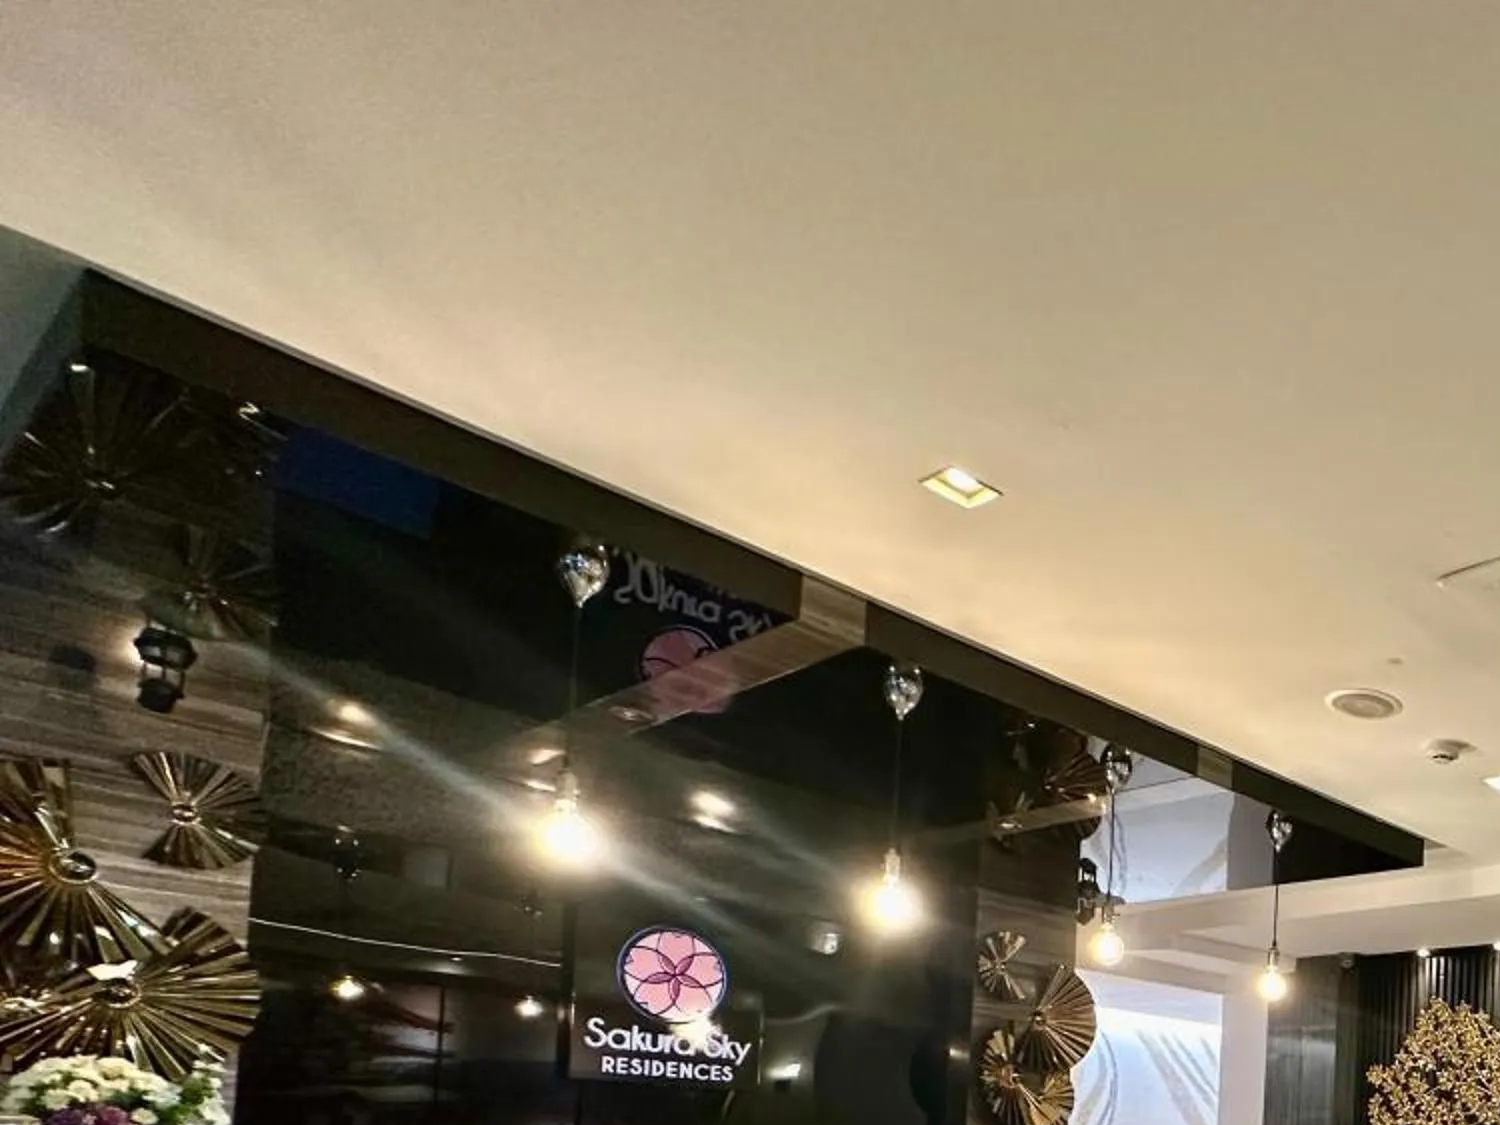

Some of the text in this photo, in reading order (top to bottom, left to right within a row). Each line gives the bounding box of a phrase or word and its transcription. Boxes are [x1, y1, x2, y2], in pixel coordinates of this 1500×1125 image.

[584, 1017, 752, 1066] Sakura Sky
[601, 1055, 733, 1082] RESIDENCES
